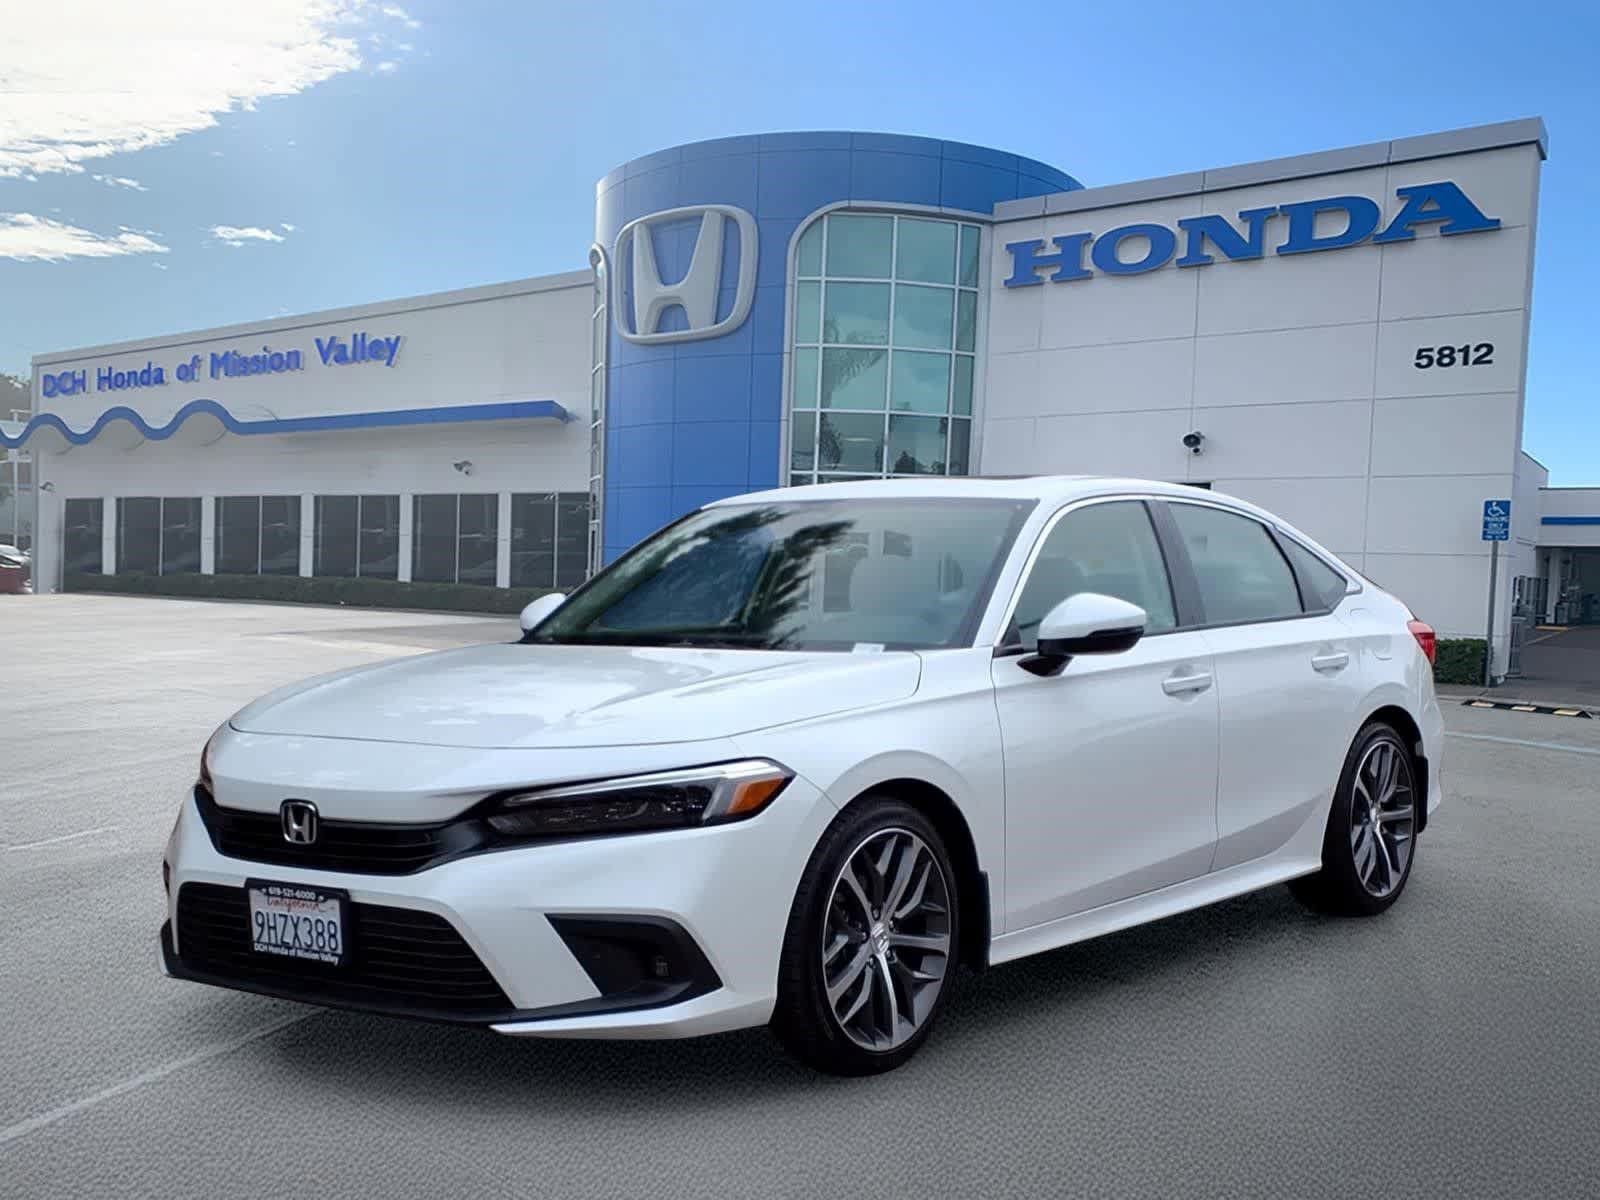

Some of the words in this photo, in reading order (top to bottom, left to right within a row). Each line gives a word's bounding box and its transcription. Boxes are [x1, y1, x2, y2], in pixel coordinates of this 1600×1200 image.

[1003, 181, 1501, 288] HONDA
[43, 370, 87, 398] DCH
[97, 361, 166, 391] Honda
[176, 356, 202, 382] of
[210, 346, 303, 380] Mission
[314, 333, 405, 368] Valley
[1414, 342, 1494, 370] 5812
[254, 910, 339, 952] 9HZX388
